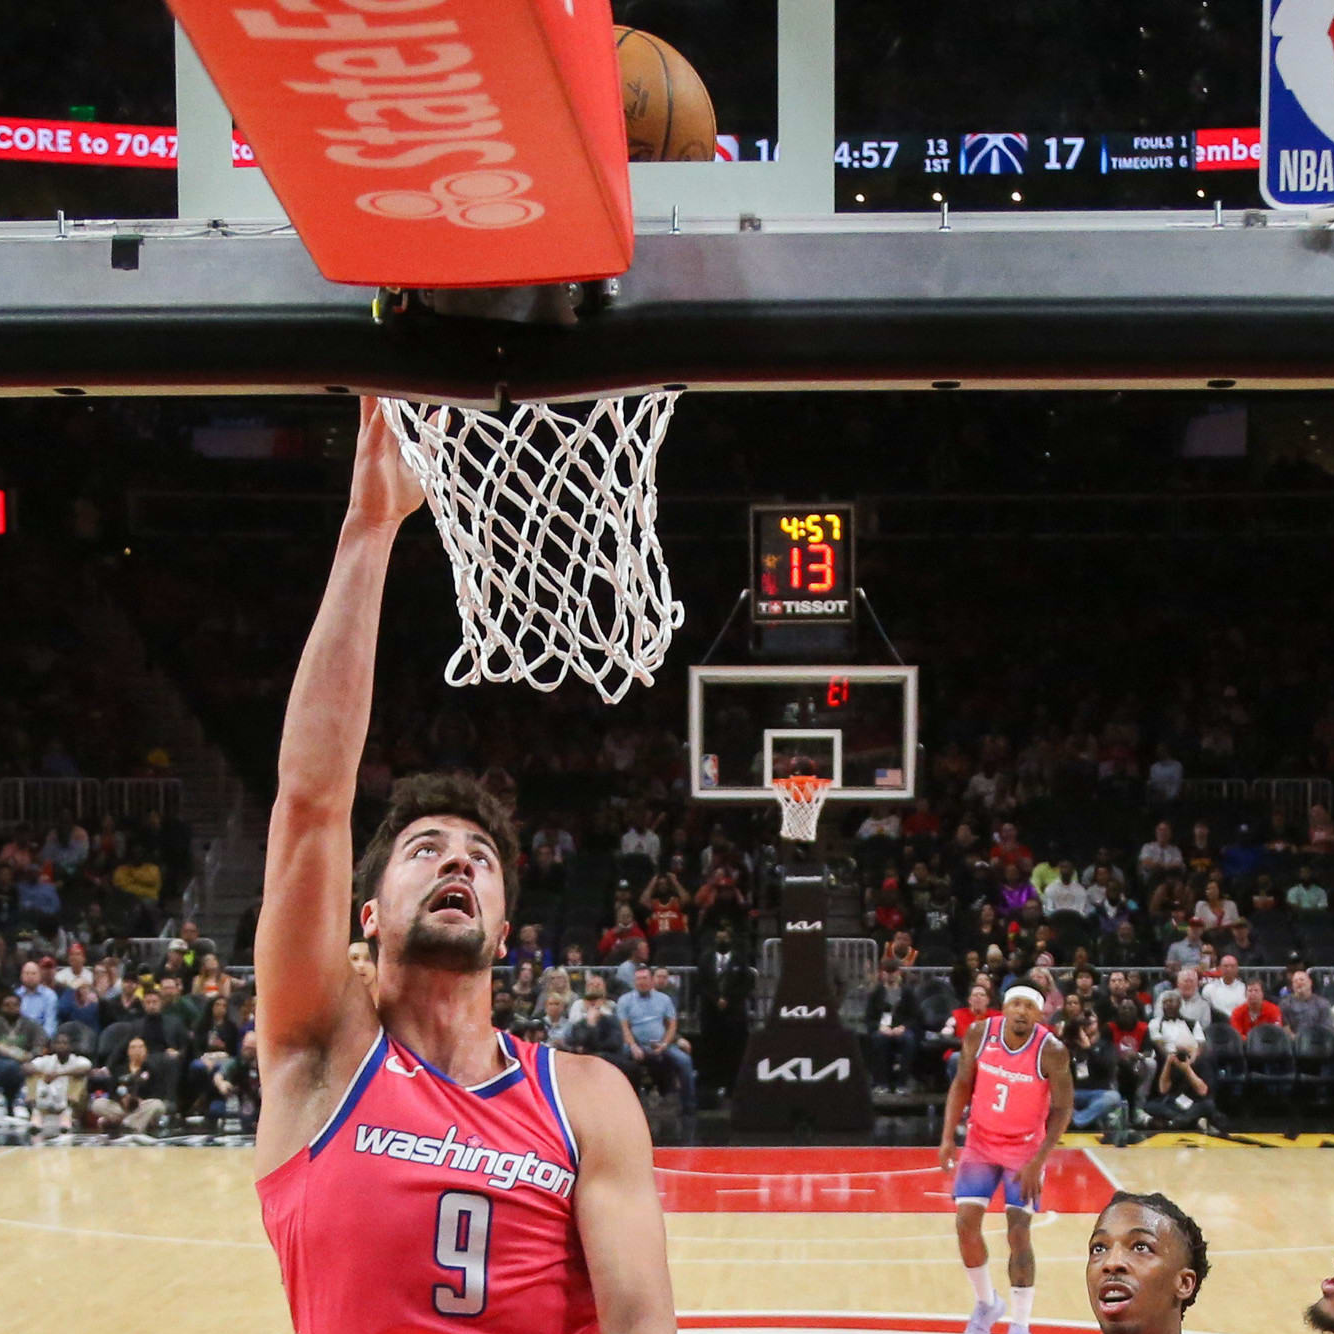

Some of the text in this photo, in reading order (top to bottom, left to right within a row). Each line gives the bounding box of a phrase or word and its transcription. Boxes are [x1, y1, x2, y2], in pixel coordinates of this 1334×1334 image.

[78, 132, 110, 156] to
[115, 132, 178, 160] 7047
[834, 141, 899, 169] 4:57
[925, 138, 949, 156] 13
[1043, 137, 1085, 170] 17
[1133, 136, 1188, 150] FOULS 1
[923, 159, 951, 173] 1ST
[1110, 155, 1189, 170] TIMEOUTS 6
[1278, 149, 1334, 192] NBA
[781, 514, 842, 543] 4:57
[790, 543, 835, 592] 13
[783, 600, 849, 614] TISSOT
[992, 1083, 1009, 1113] 3
[354, 1125, 575, 1200] washington
[432, 1190, 494, 1317] 9
